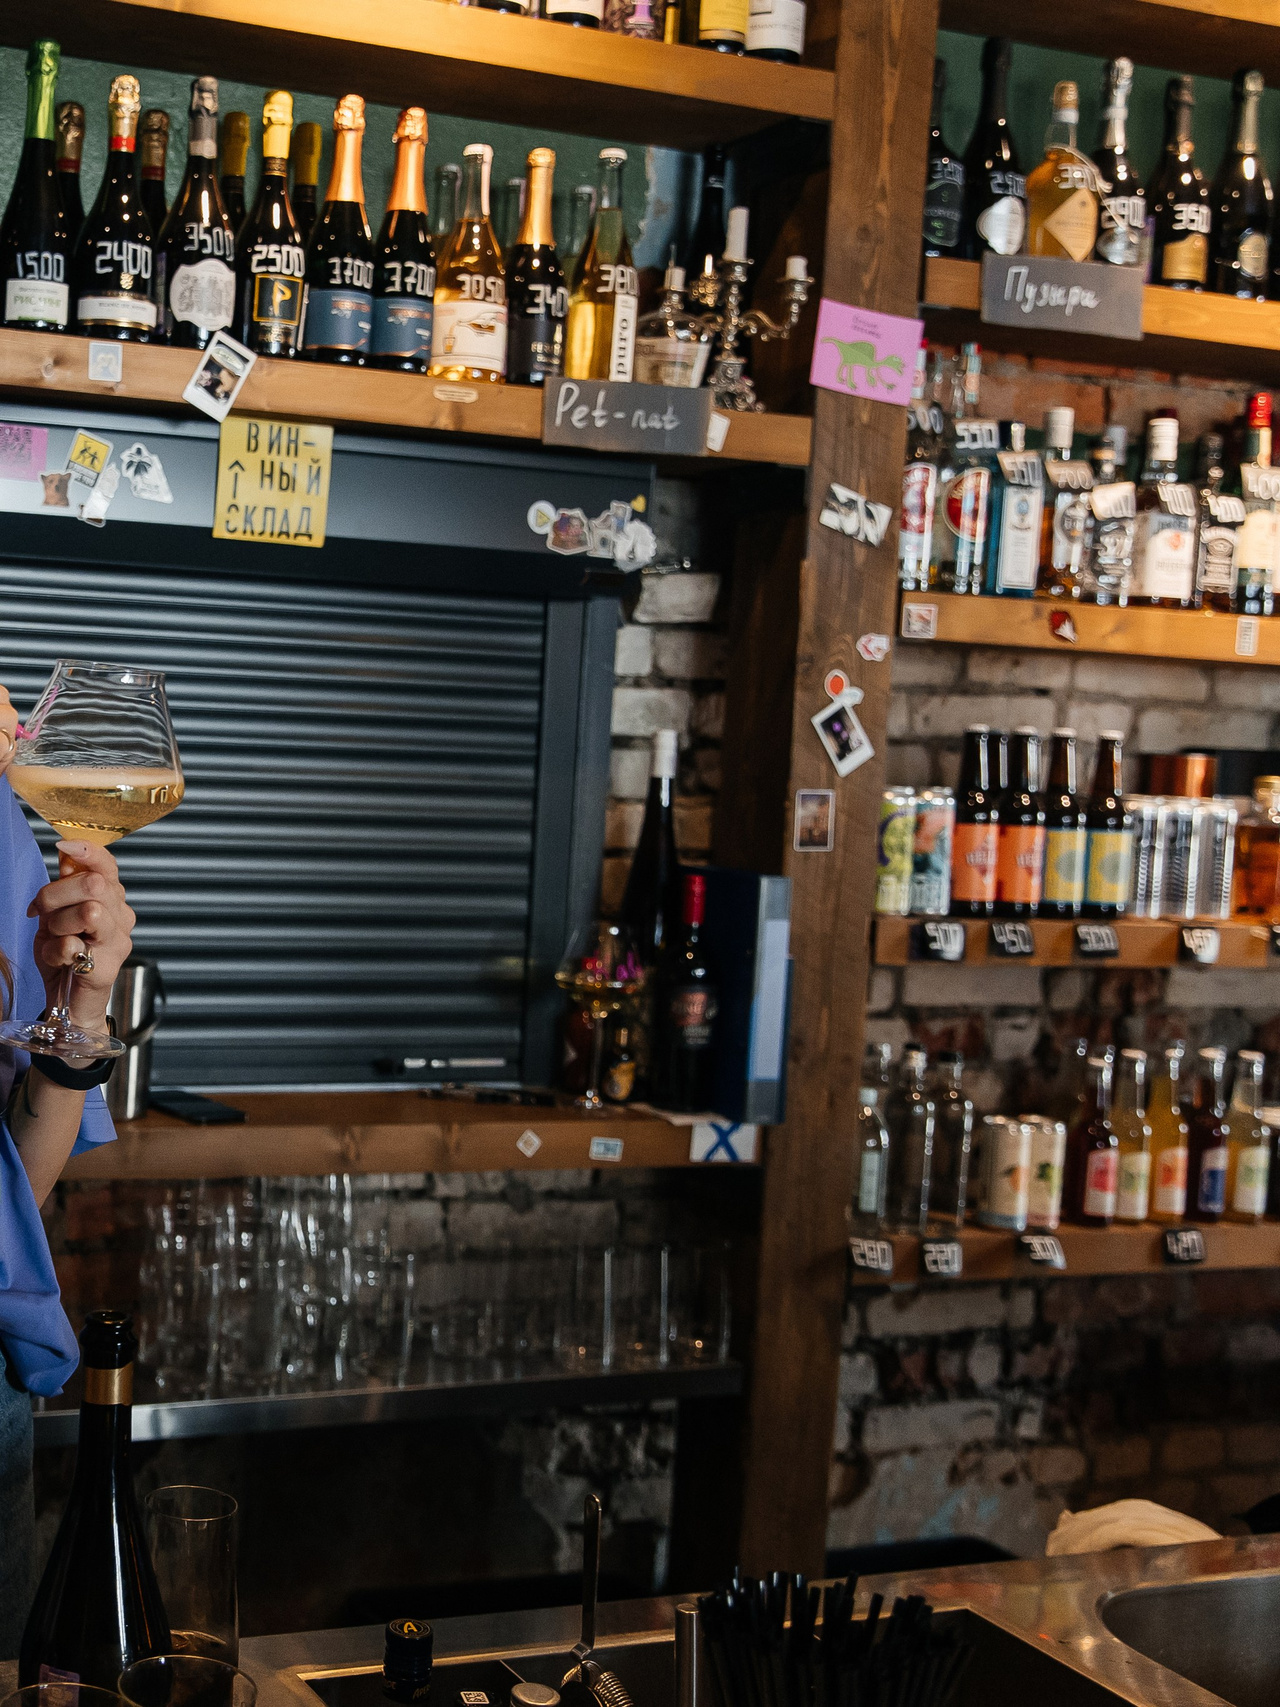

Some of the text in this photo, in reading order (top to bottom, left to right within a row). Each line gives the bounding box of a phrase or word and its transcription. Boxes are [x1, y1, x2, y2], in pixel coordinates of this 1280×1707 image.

[95, 240, 152, 279] 2400
[184, 222, 234, 262] 3500
[251, 244, 306, 278] 2500
[16, 252, 65, 282] 1500
[328, 256, 375, 290] 3700
[384, 261, 437, 298] 3700
[554, 381, 681, 431] Pet-nat
[246, 421, 317, 458] ВИН-
[260, 456, 322, 497] НЫЙ
[225, 503, 314, 542] СКЛАД
